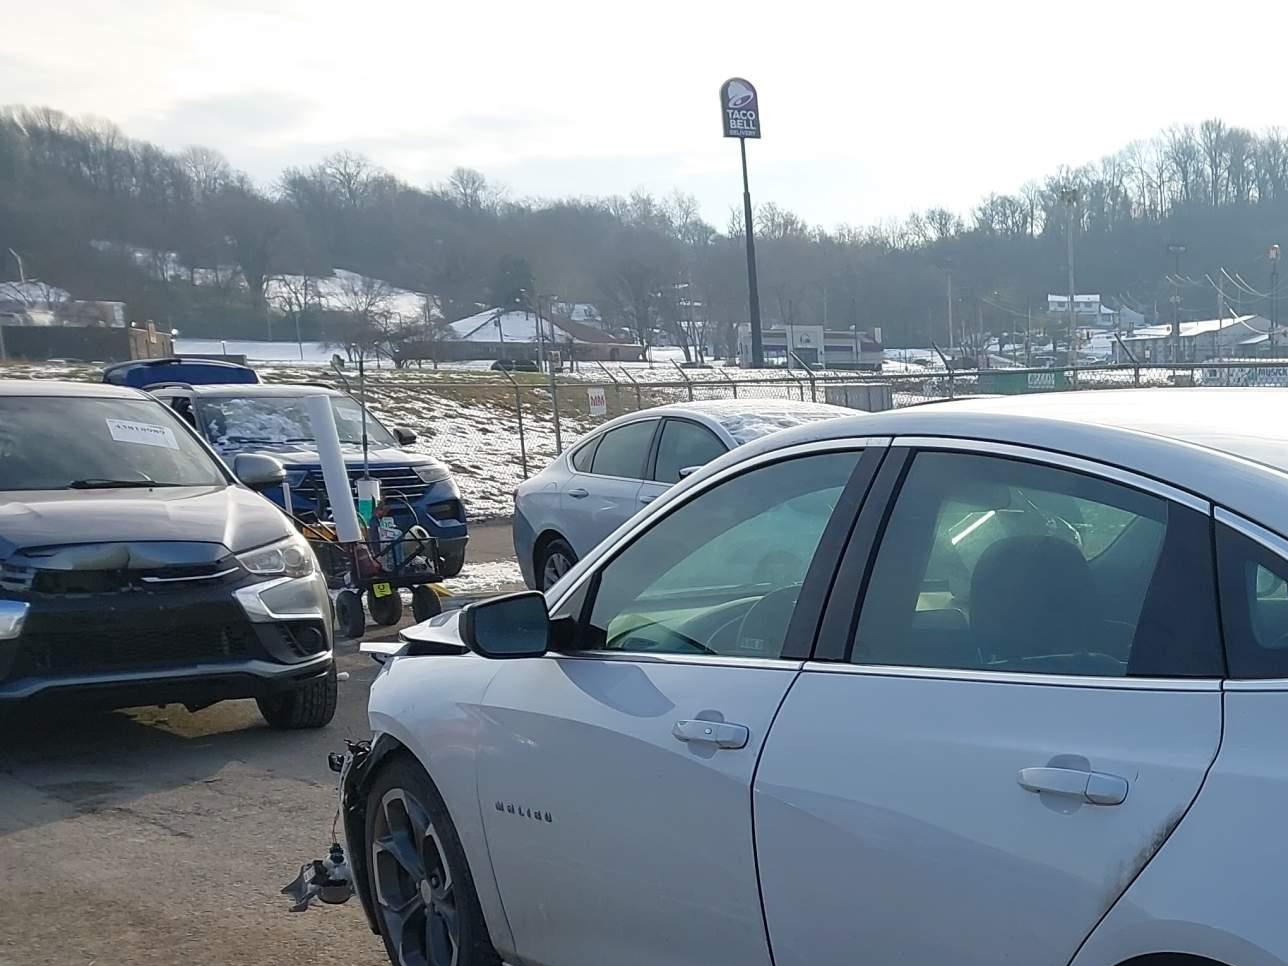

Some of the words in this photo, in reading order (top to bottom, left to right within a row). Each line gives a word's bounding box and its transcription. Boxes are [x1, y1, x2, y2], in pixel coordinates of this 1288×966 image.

[727, 109, 756, 120] TACO
[729, 119, 756, 130] BELL
[494, 800, 553, 823] MALIBU
